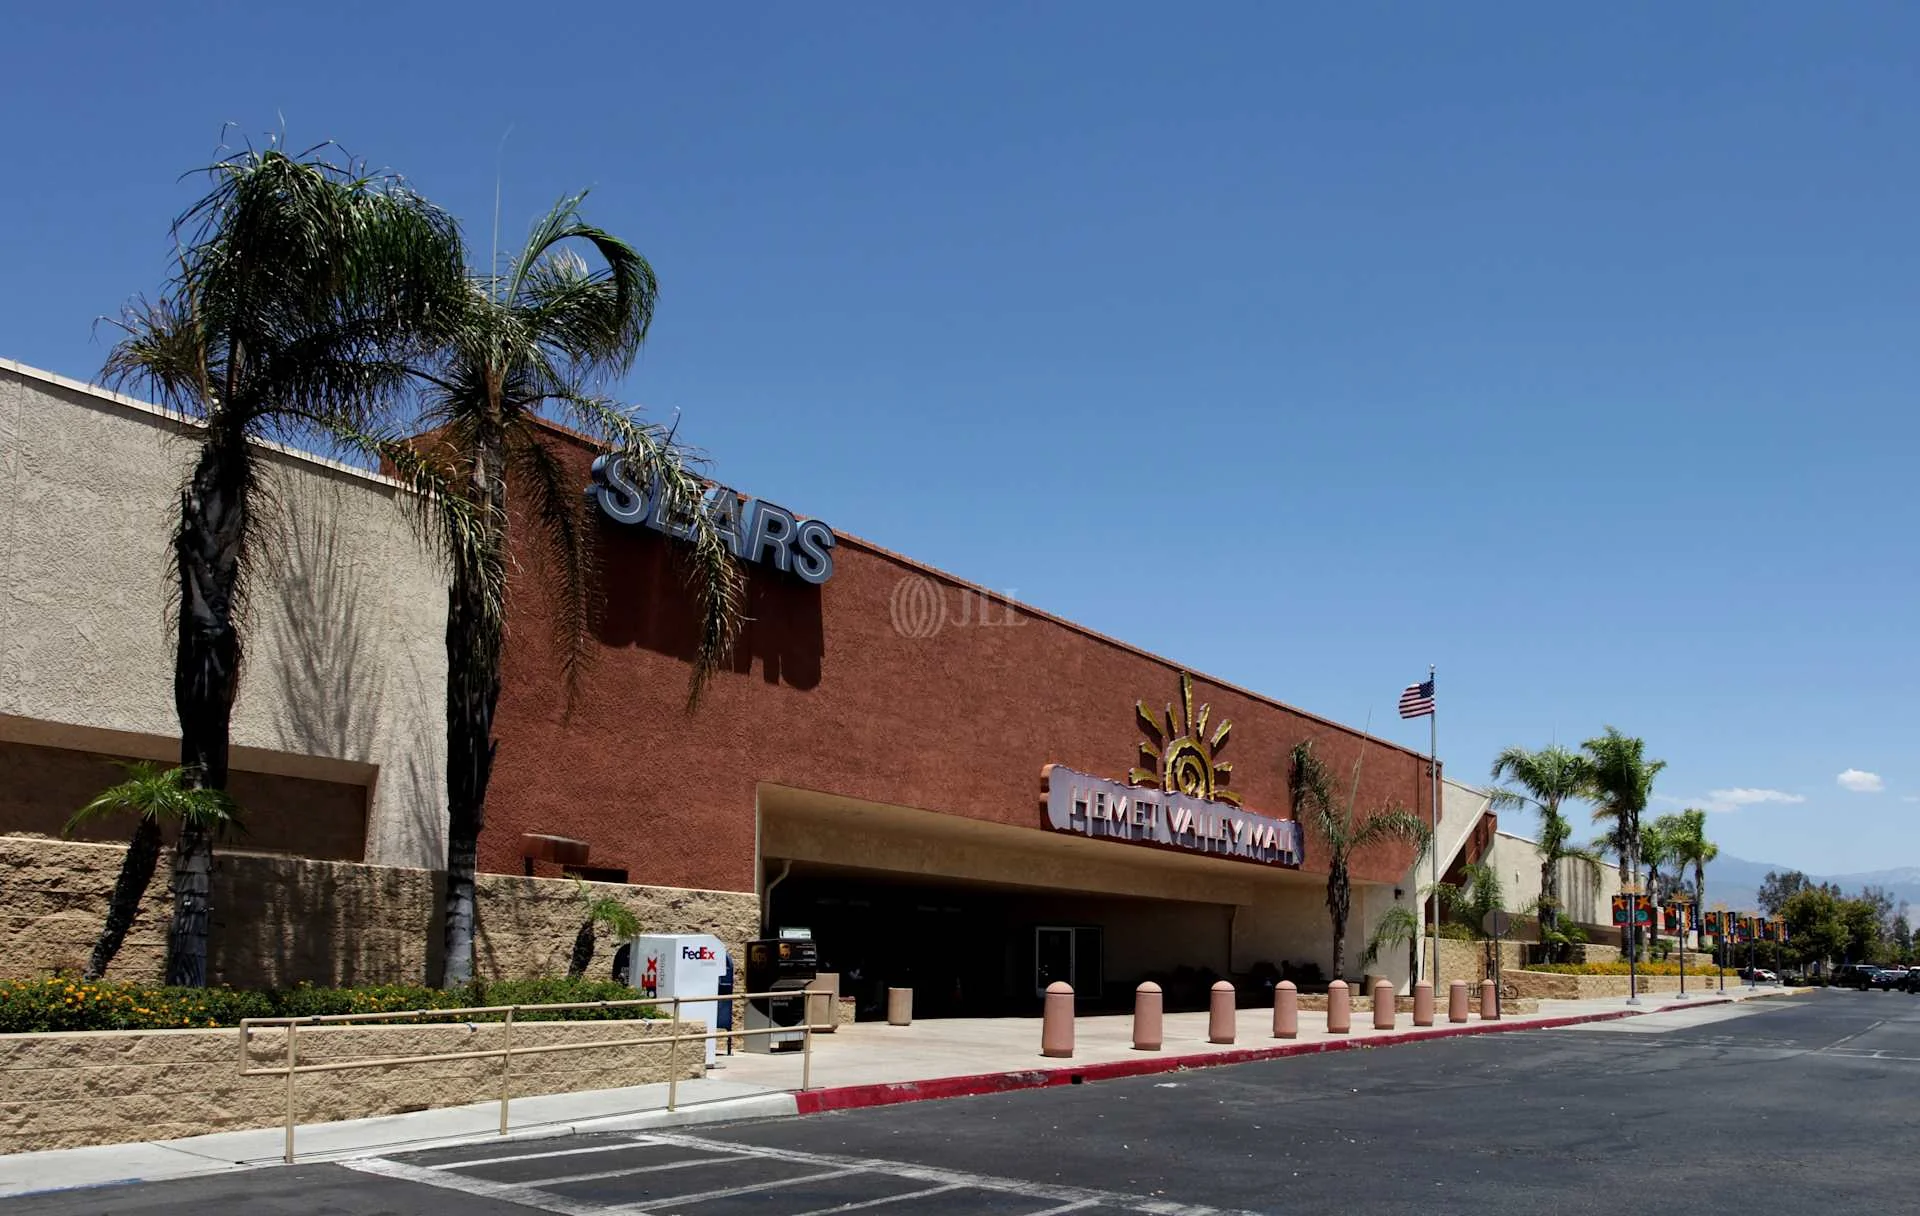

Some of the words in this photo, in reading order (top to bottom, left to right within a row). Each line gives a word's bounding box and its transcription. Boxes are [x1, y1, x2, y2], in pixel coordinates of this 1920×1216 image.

[1069, 785, 1160, 829] HEMET
[1166, 806, 1244, 844] VALLEY
[1247, 823, 1293, 852] MALL
[657, 952, 666, 988] Express
[682, 946, 716, 960] FedEx
